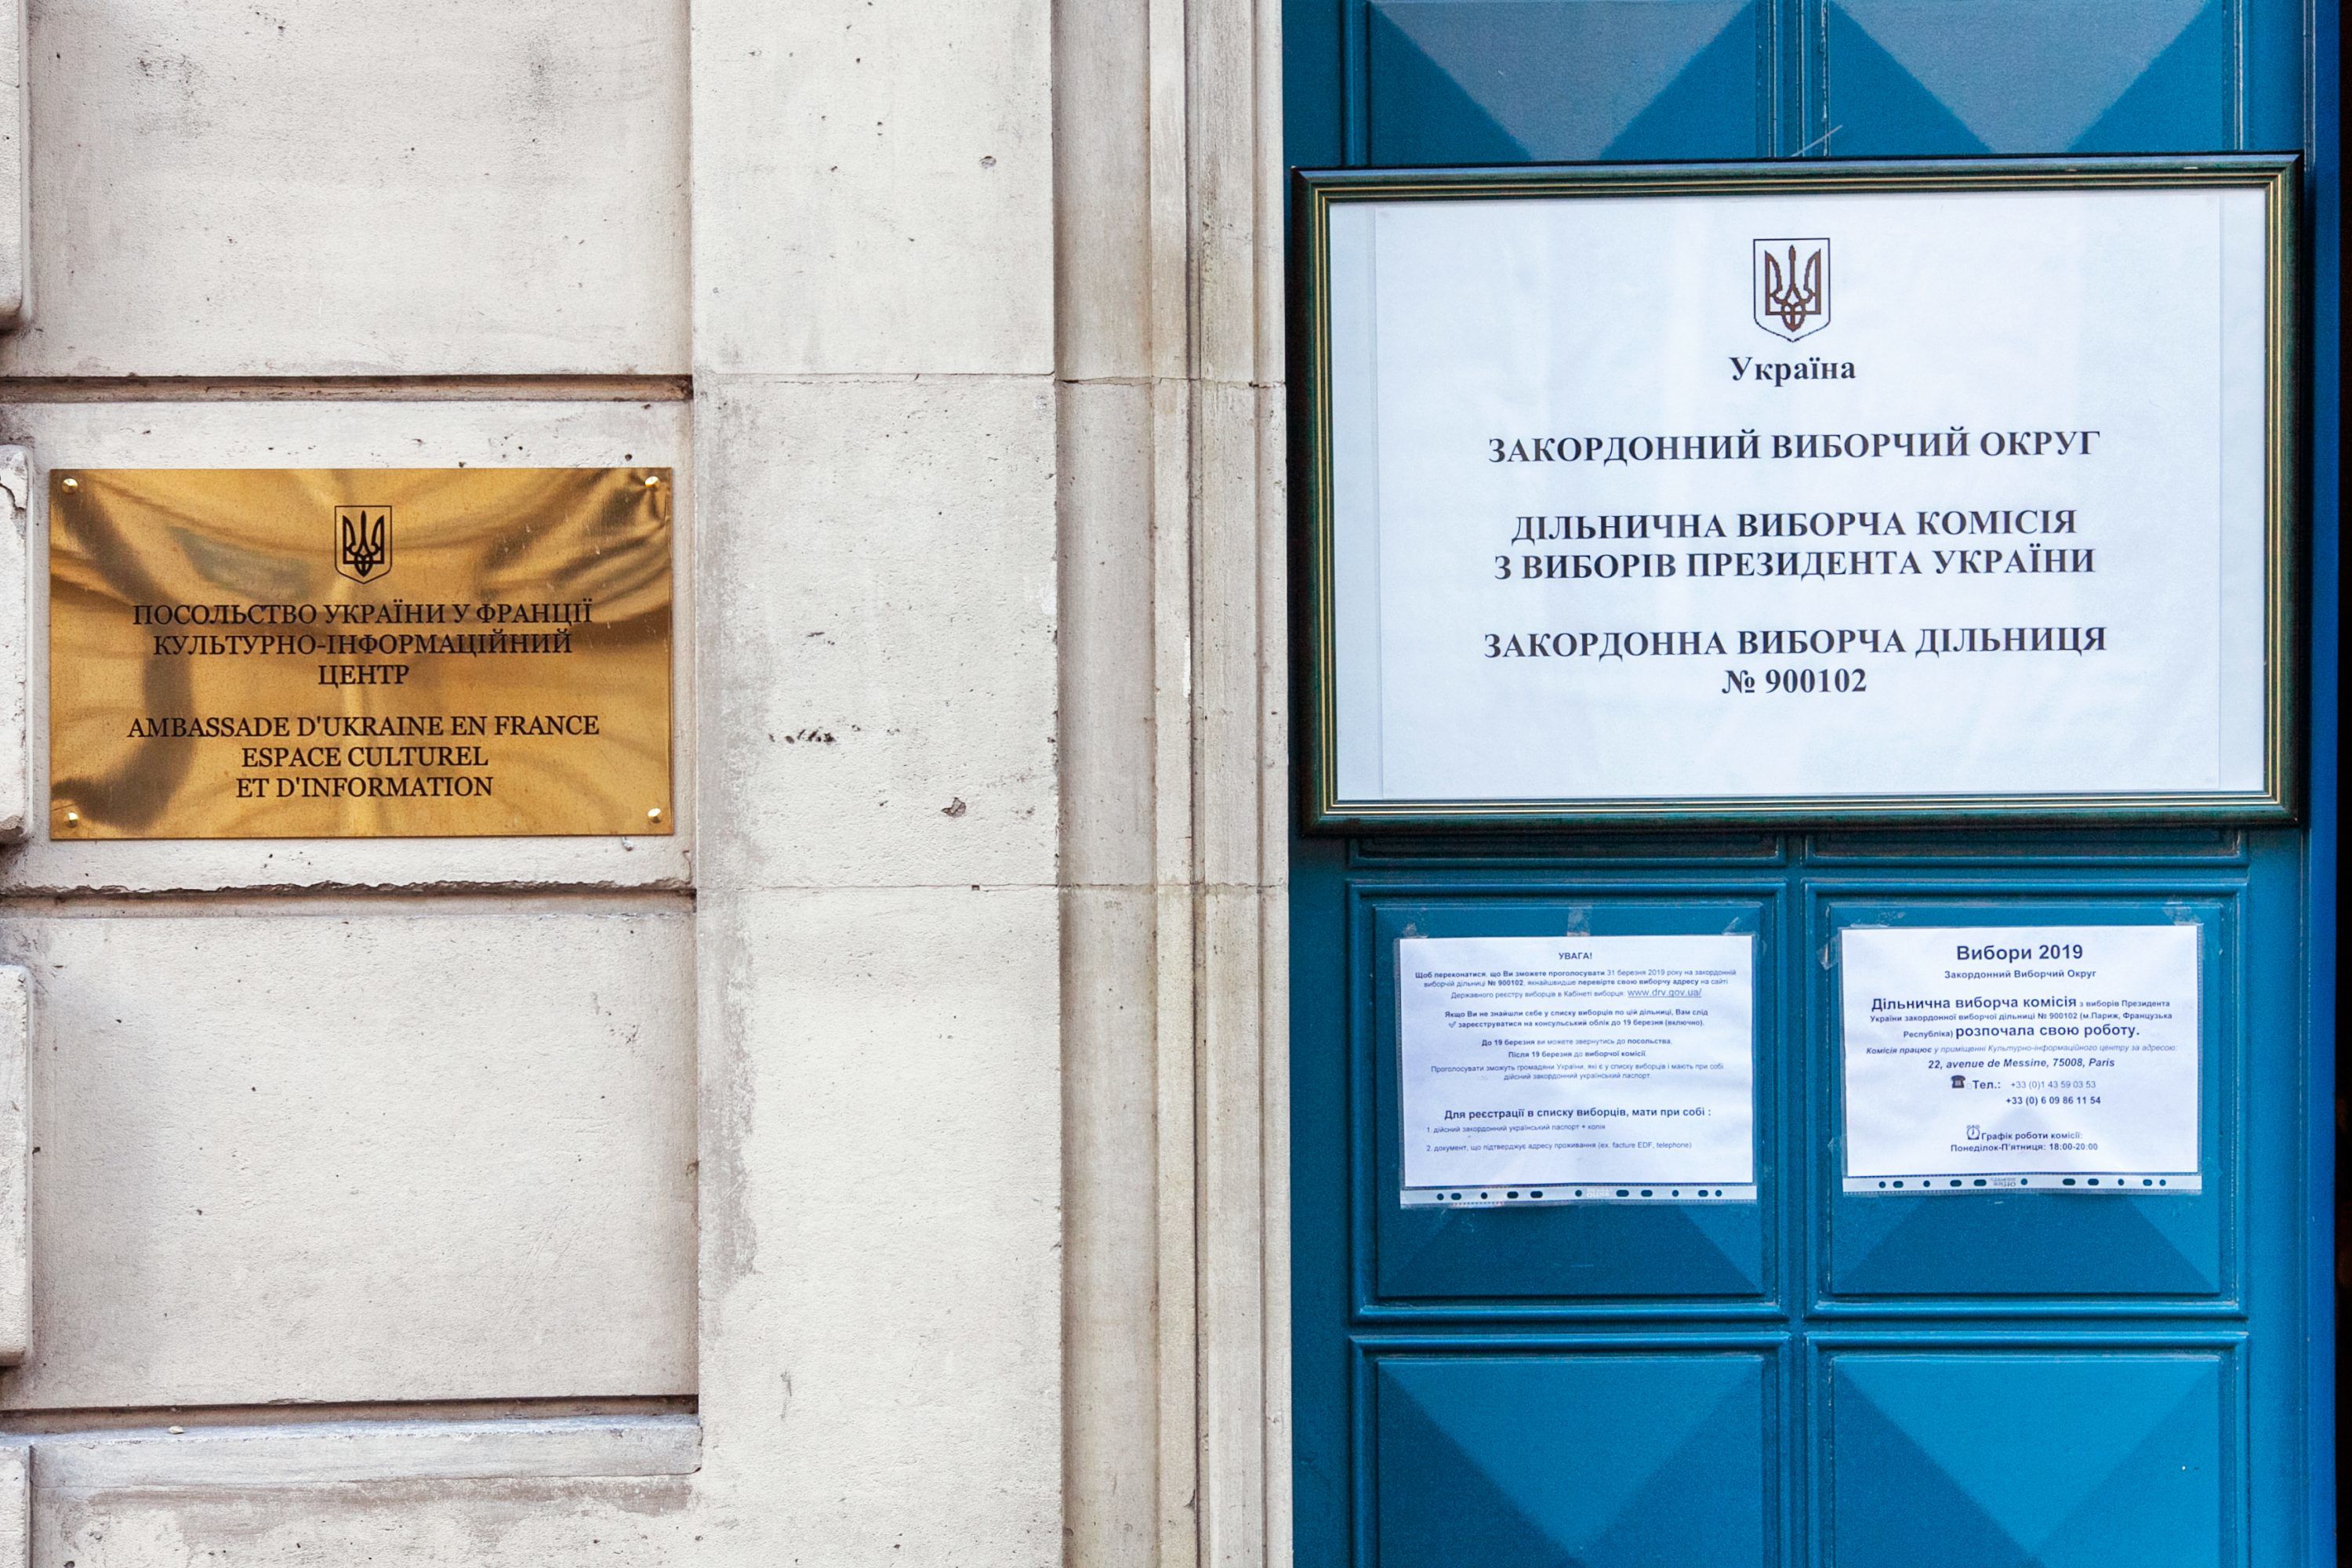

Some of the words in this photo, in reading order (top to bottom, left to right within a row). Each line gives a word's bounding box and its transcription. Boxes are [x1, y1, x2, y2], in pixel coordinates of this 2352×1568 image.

[1729, 357, 1856, 387] Україна
[1489, 428, 1760, 466] ЗАКОРДОННИЙ
[1772, 426, 1969, 459] ВИБОРЧИЙ
[1980, 430, 2100, 456] ОКРУГ
[1511, 514, 1727, 546] ДІЛЬНИЧНА
[1737, 512, 1907, 538] ВИБОРЧА
[1917, 510, 2077, 535] КОМІСІЯ
[1494, 555, 1512, 580] З
[1523, 554, 1676, 579] ВИБОРІВ
[1687, 550, 1922, 581] ПРЕЗИДЕНТА
[1932, 543, 2094, 575] УКРАЇНИ
[132, 604, 317, 625] ПОСОЛЬСТВО
[323, 599, 446, 624] УКРАЇНИ
[454, 604, 470, 623] У
[476, 598, 593, 626] ФРАНЦІЇ
[153, 628, 572, 657] КУЛЬТУРНО-ІНФОРМАЦІЙНИЙ
[1485, 631, 1727, 662] ЗАКОРДОННА
[1738, 629, 1907, 655] ВИБОРЧА
[1915, 626, 2106, 659] ДІЛЬНИЦЯ
[318, 665, 410, 688] ЦЕНТР
[1722, 670, 1755, 695] №
[1765, 668, 1867, 694] 900102
[126, 717, 290, 738] AMBASSADE
[296, 715, 445, 737] D'UKRAINE
[450, 716, 488, 736] EN
[494, 714, 600, 735] FRANCE
[241, 746, 342, 768] ESPACE
[347, 746, 488, 768] CULTUREL
[235, 778, 270, 798] ET
[276, 776, 494, 798] D'INFORMATION
[1957, 945, 2032, 964] Вибори
[2039, 944, 2083, 960] 2019
[1944, 970, 2011, 981] Закордонний
[2013, 969, 2064, 980] Виборчий
[2067, 969, 2096, 979] Округ
[1871, 998, 1951, 1012] Дільнична
[1955, 996, 2018, 1011] виборча
[2023, 996, 2077, 1007] комісія
[2085, 1000, 2120, 1008] виборів
[2122, 1000, 2170, 1008] Президента
[1958, 1013, 1997, 1022] виборчої
[2080, 1011, 2121, 1021] (м.Париж,
[2122, 1012, 2172, 1021] Французька
[1903, 1029, 1954, 1040] Республіка)
[1955, 1027, 2034, 1040] розпочала
[2039, 1026, 2079, 1036] свою
[2084, 1023, 2140, 1039] роботу.
[1928, 1060, 1943, 1070] 22,
[1987, 1058, 2001, 1068] de
[2003, 1058, 2049, 1068] Messine,
[2053, 1058, 2085, 1068] 75008,
[2089, 1058, 2115, 1067] Paris
[1972, 1080, 2001, 1090] Тел.:
[2029, 1080, 2045, 1090] (0)1
[2060, 1080, 2071, 1089] 59
[2085, 1080, 2096, 1089] 53
[2005, 1096, 2023, 1105] +33
[2025, 1096, 2038, 1106] (0)
[2041, 1096, 2047, 1105] 6
[2049, 1096, 2060, 1105] 09
[2063, 1096, 2074, 1105] 86
[2077, 1096, 2086, 1105] 11
[2090, 1096, 2101, 1105] 54
[1981, 1132, 2013, 1142] Графік
[2015, 1131, 2049, 1141] роботи
[2049, 1142, 2098, 1151] 18:00-20:00
